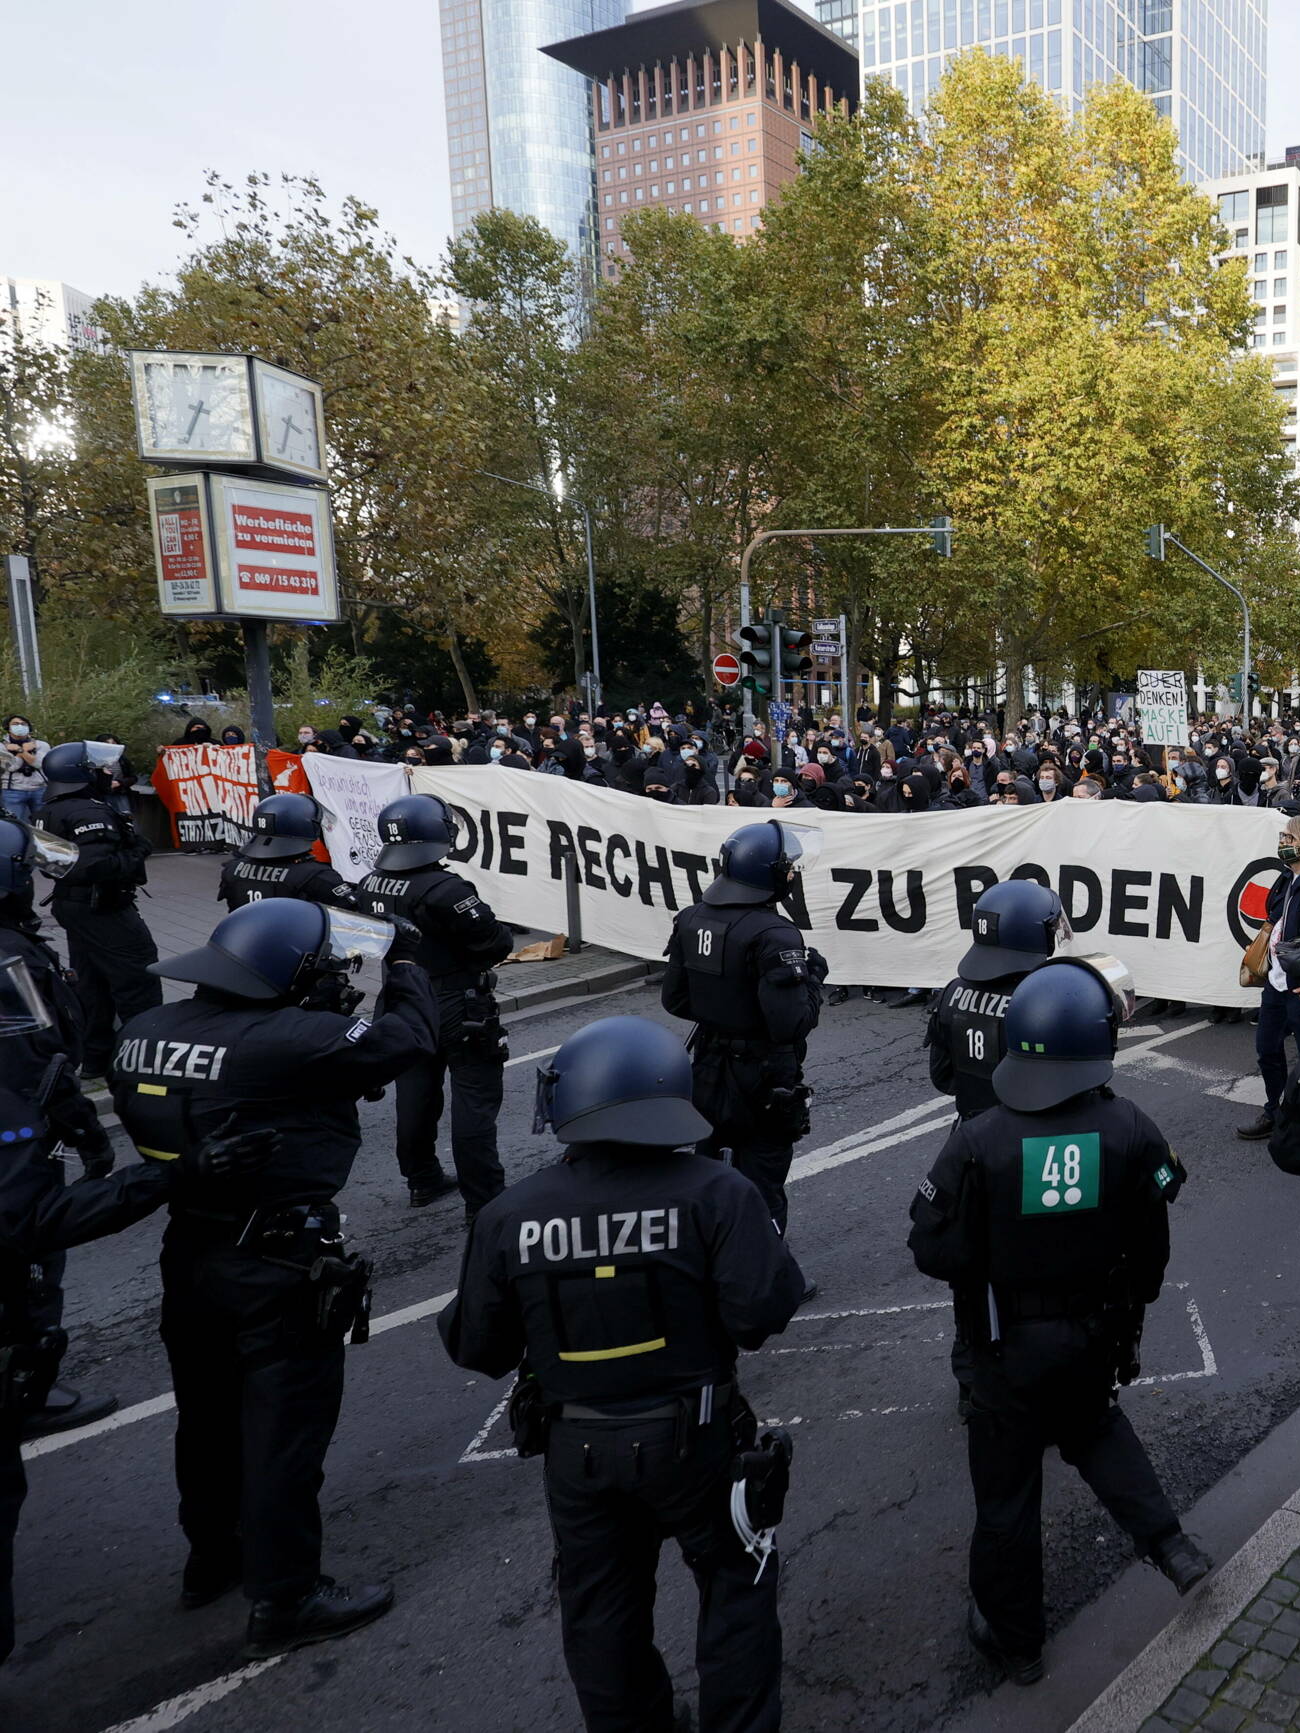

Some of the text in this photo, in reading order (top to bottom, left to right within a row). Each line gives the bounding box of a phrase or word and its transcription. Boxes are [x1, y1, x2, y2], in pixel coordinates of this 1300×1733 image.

[234, 514, 312, 534] Werbefläche
[237, 532, 313, 548] zu vermieten
[254, 573, 270, 585] 069
[278, 575, 288, 586] 15
[289, 575, 300, 587] 43
[1140, 690, 1183, 707] DENKEN!
[1141, 708, 1185, 725] MASKE
[1147, 724, 1181, 744] AUF!
[74, 822, 104, 836] POLIZEI
[258, 817, 266, 828] 18
[388, 823, 398, 835] 18
[233, 861, 290, 883] POLIZEI
[546, 818, 813, 931] RECHTN
[831, 867, 927, 934] ZU
[362, 874, 410, 897] POLIZEI
[978, 918, 988, 935] 18
[697, 928, 712, 957] 18
[949, 985, 1010, 1018] POLIZE
[966, 1028, 985, 1061] 18
[113, 1038, 227, 1081] POLIZEI
[1041, 1144, 1081, 1187] 48
[518, 1207, 679, 1264] POLIZEI
